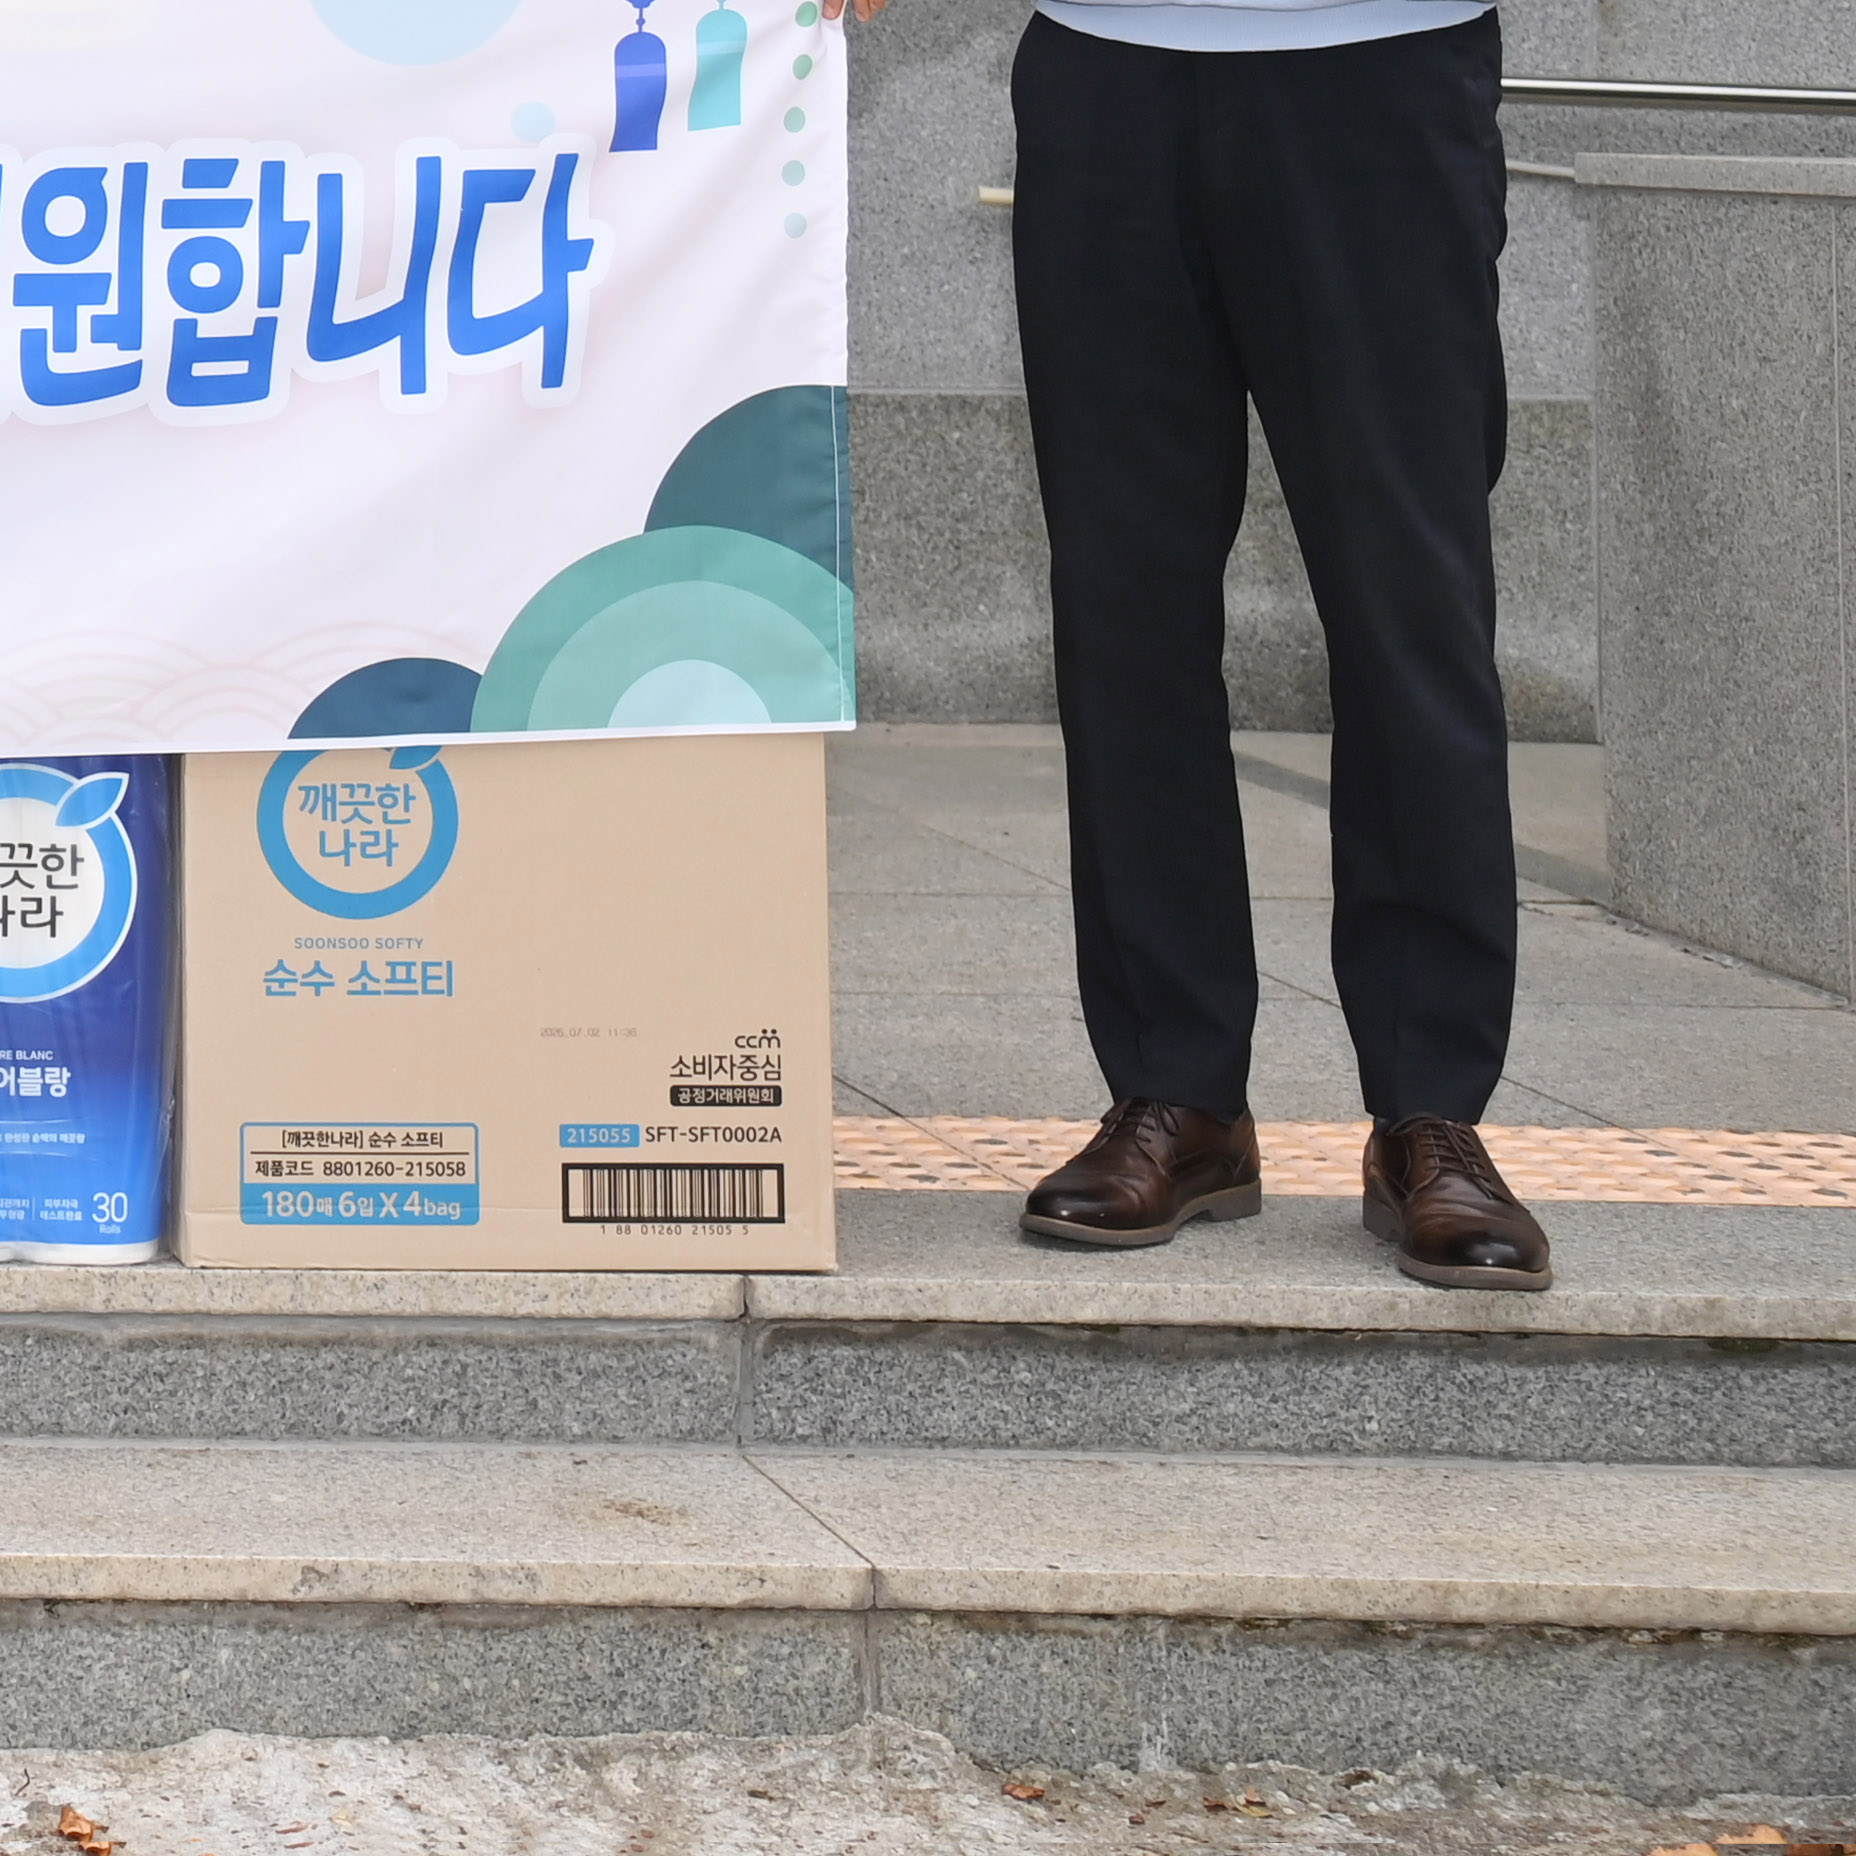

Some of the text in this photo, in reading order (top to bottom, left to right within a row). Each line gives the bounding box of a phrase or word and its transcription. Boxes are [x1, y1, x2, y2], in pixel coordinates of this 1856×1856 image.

[298, 782, 416, 826] 깨끗한
[319, 829, 399, 868] 나라
[294, 937, 424, 950] SOONSOO SOFTY
[263, 959, 455, 998] 순수 소프티
[734, 1029, 781, 1049] ccm
[16, 1049, 54, 1061] BLANC
[669, 1054, 782, 1082] 소비자중심
[677, 1087, 774, 1104] 공정거래위원회
[282, 1130, 444, 1149] [깨끗한나라] 순수 소프티
[567, 1128, 631, 1144] 215055
[645, 1126, 782, 1143] SFT-SFT0002A
[255, 1160, 467, 1177] 제품코드 8801260-215058
[91, 1191, 128, 1223] 30
[261, 1190, 461, 1220] 180매 6입 X 4bag
[615, 1225, 632, 1235] 88
[640, 1225, 682, 1235] 01260
[691, 1225, 733, 1235] 21505
